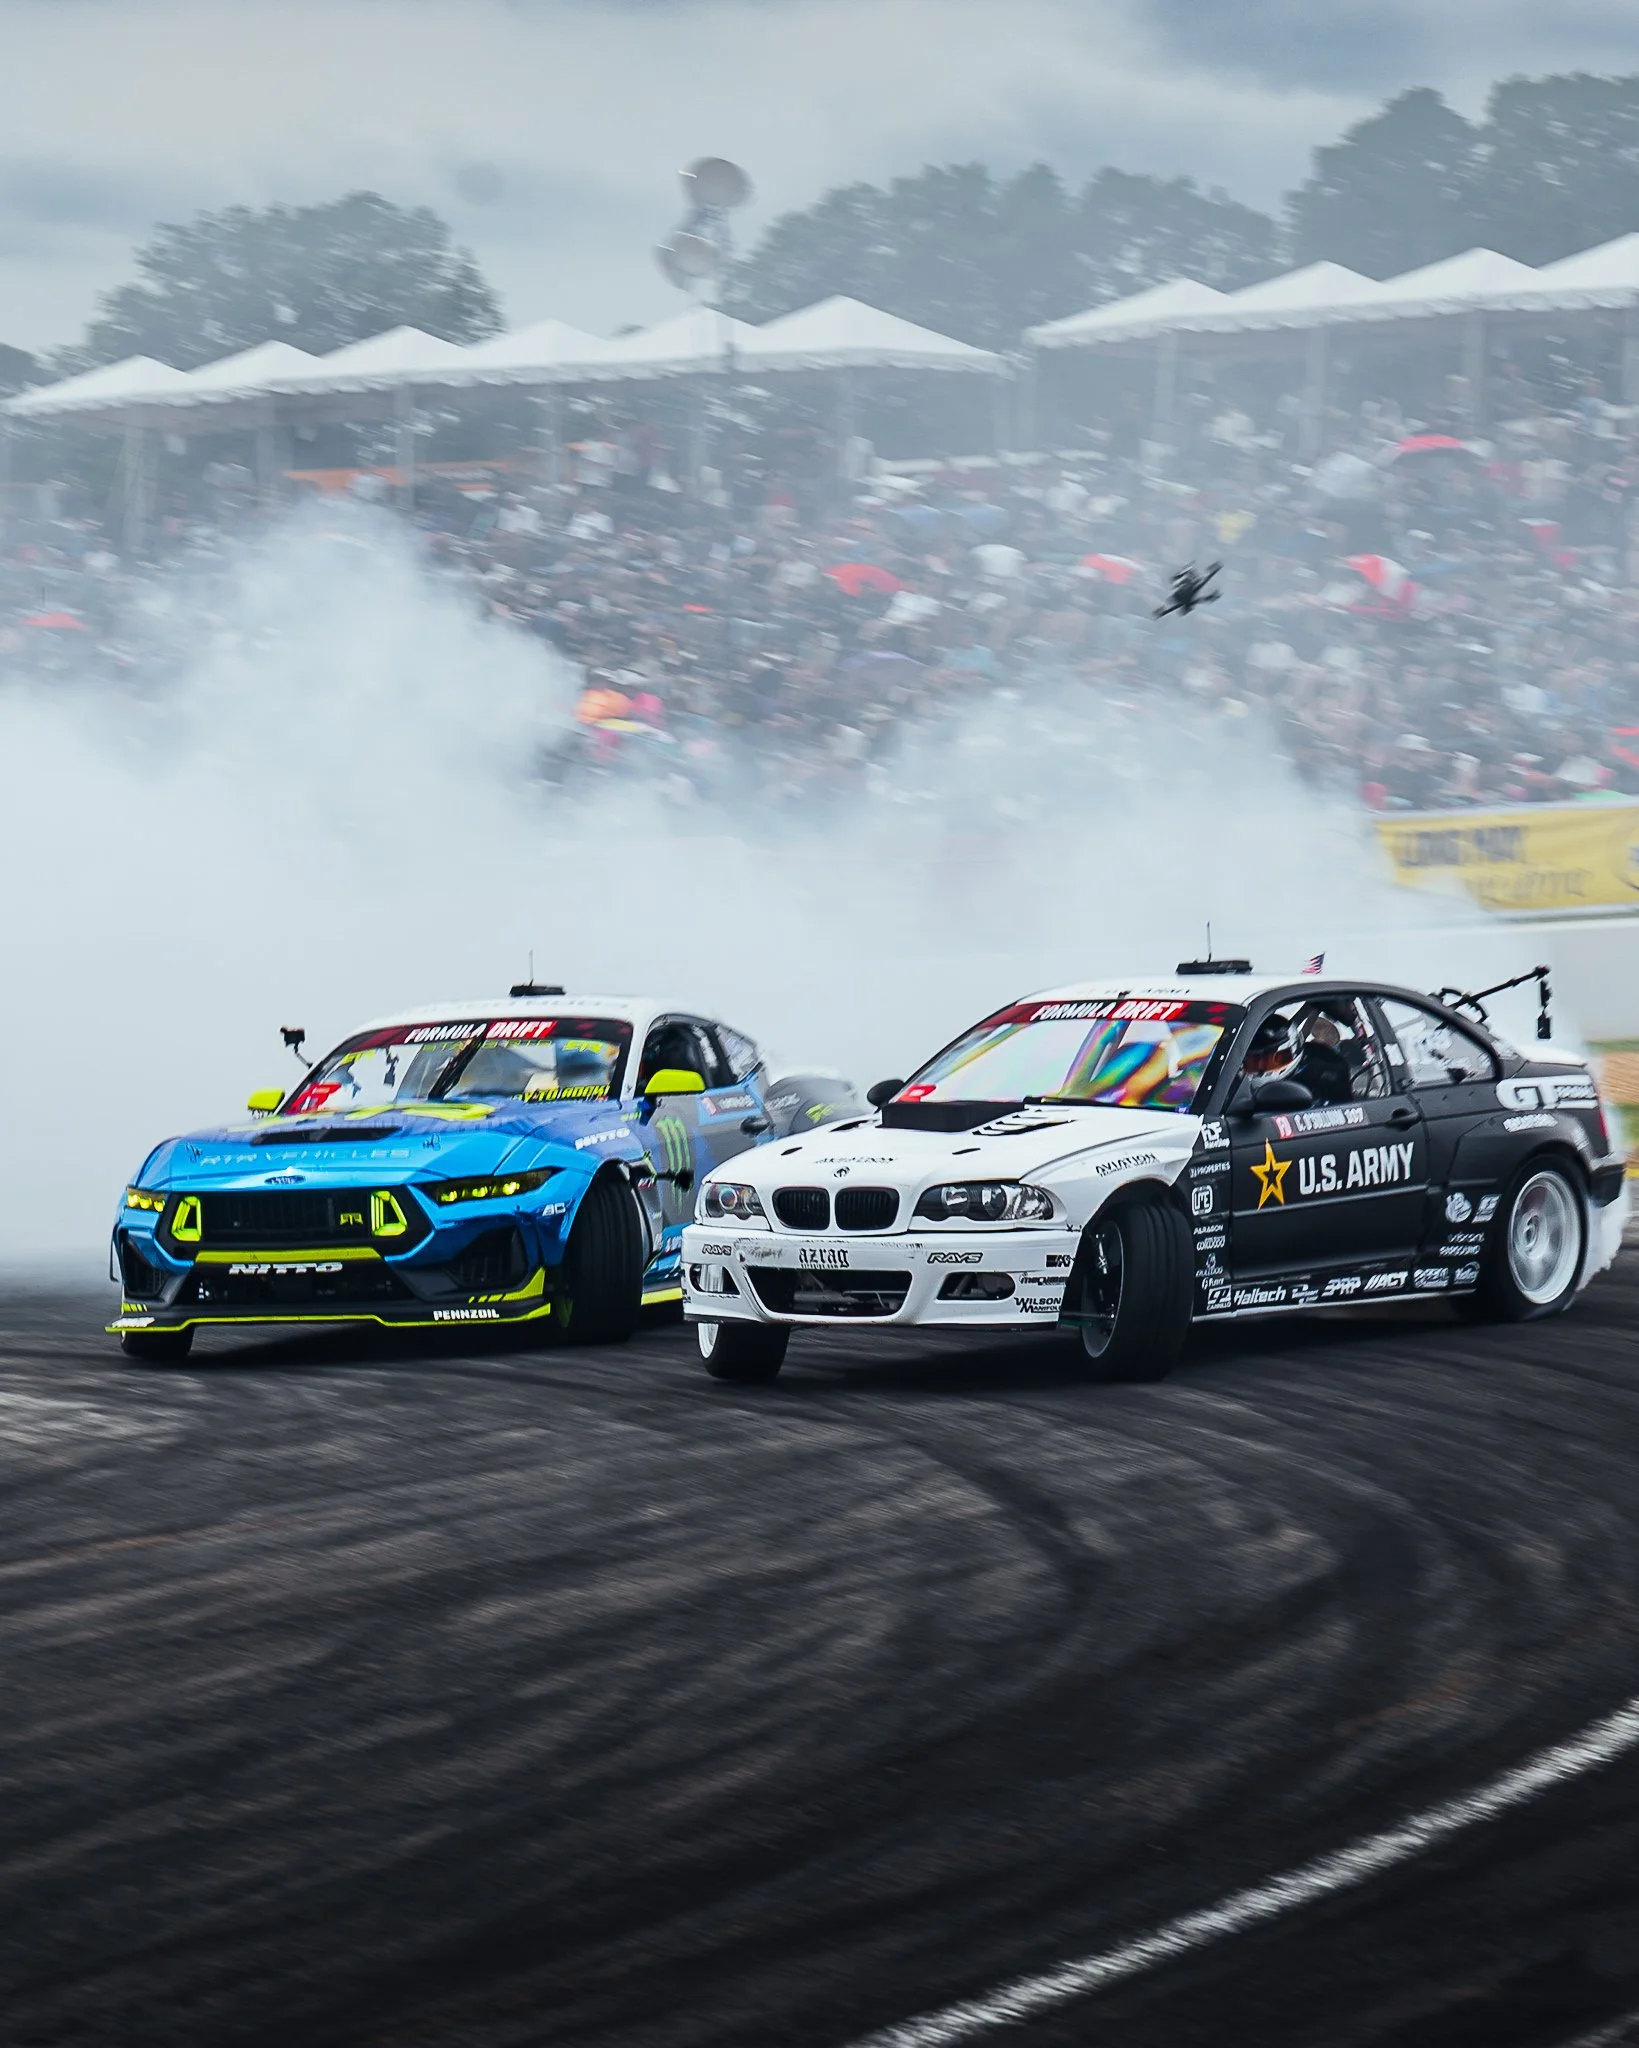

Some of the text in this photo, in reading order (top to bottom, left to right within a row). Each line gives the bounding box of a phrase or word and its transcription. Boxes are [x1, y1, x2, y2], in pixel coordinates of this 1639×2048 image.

[1029, 1001, 1186, 1021] FORMULA DRIFT
[403, 1020, 555, 1044] FORMULA DRIFT
[1299, 1141, 1415, 1195] U.S. ARMY
[701, 1243, 733, 1256] RAYS
[799, 1247, 850, 1268] azrag
[927, 1252, 983, 1264] RAYS
[228, 1261, 344, 1276] NITTO
[1014, 1296, 1062, 1306] WILSON
[1233, 1285, 1286, 1305] Haltech
[432, 1307, 500, 1321] PENNZOIL
